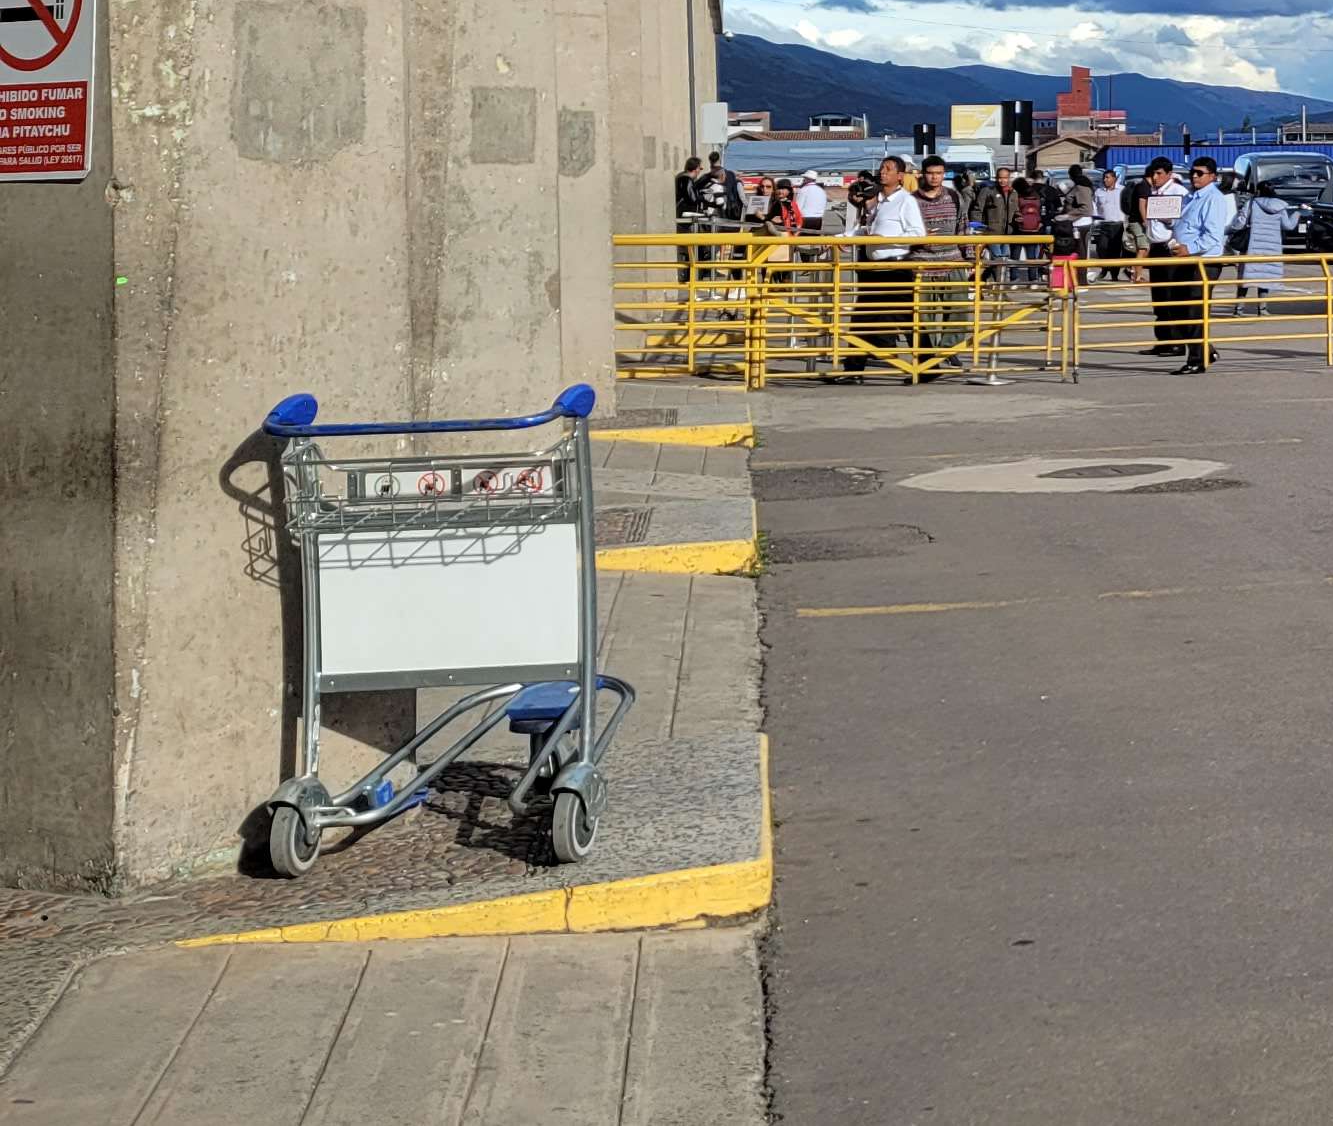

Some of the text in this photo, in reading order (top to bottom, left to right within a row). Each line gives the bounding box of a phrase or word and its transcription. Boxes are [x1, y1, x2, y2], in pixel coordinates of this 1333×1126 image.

[0, 88, 83, 102] HIBIDO FUMAR
[0, 106, 65, 120] O SMOKING
[13, 124, 70, 138] PITAYCHU
